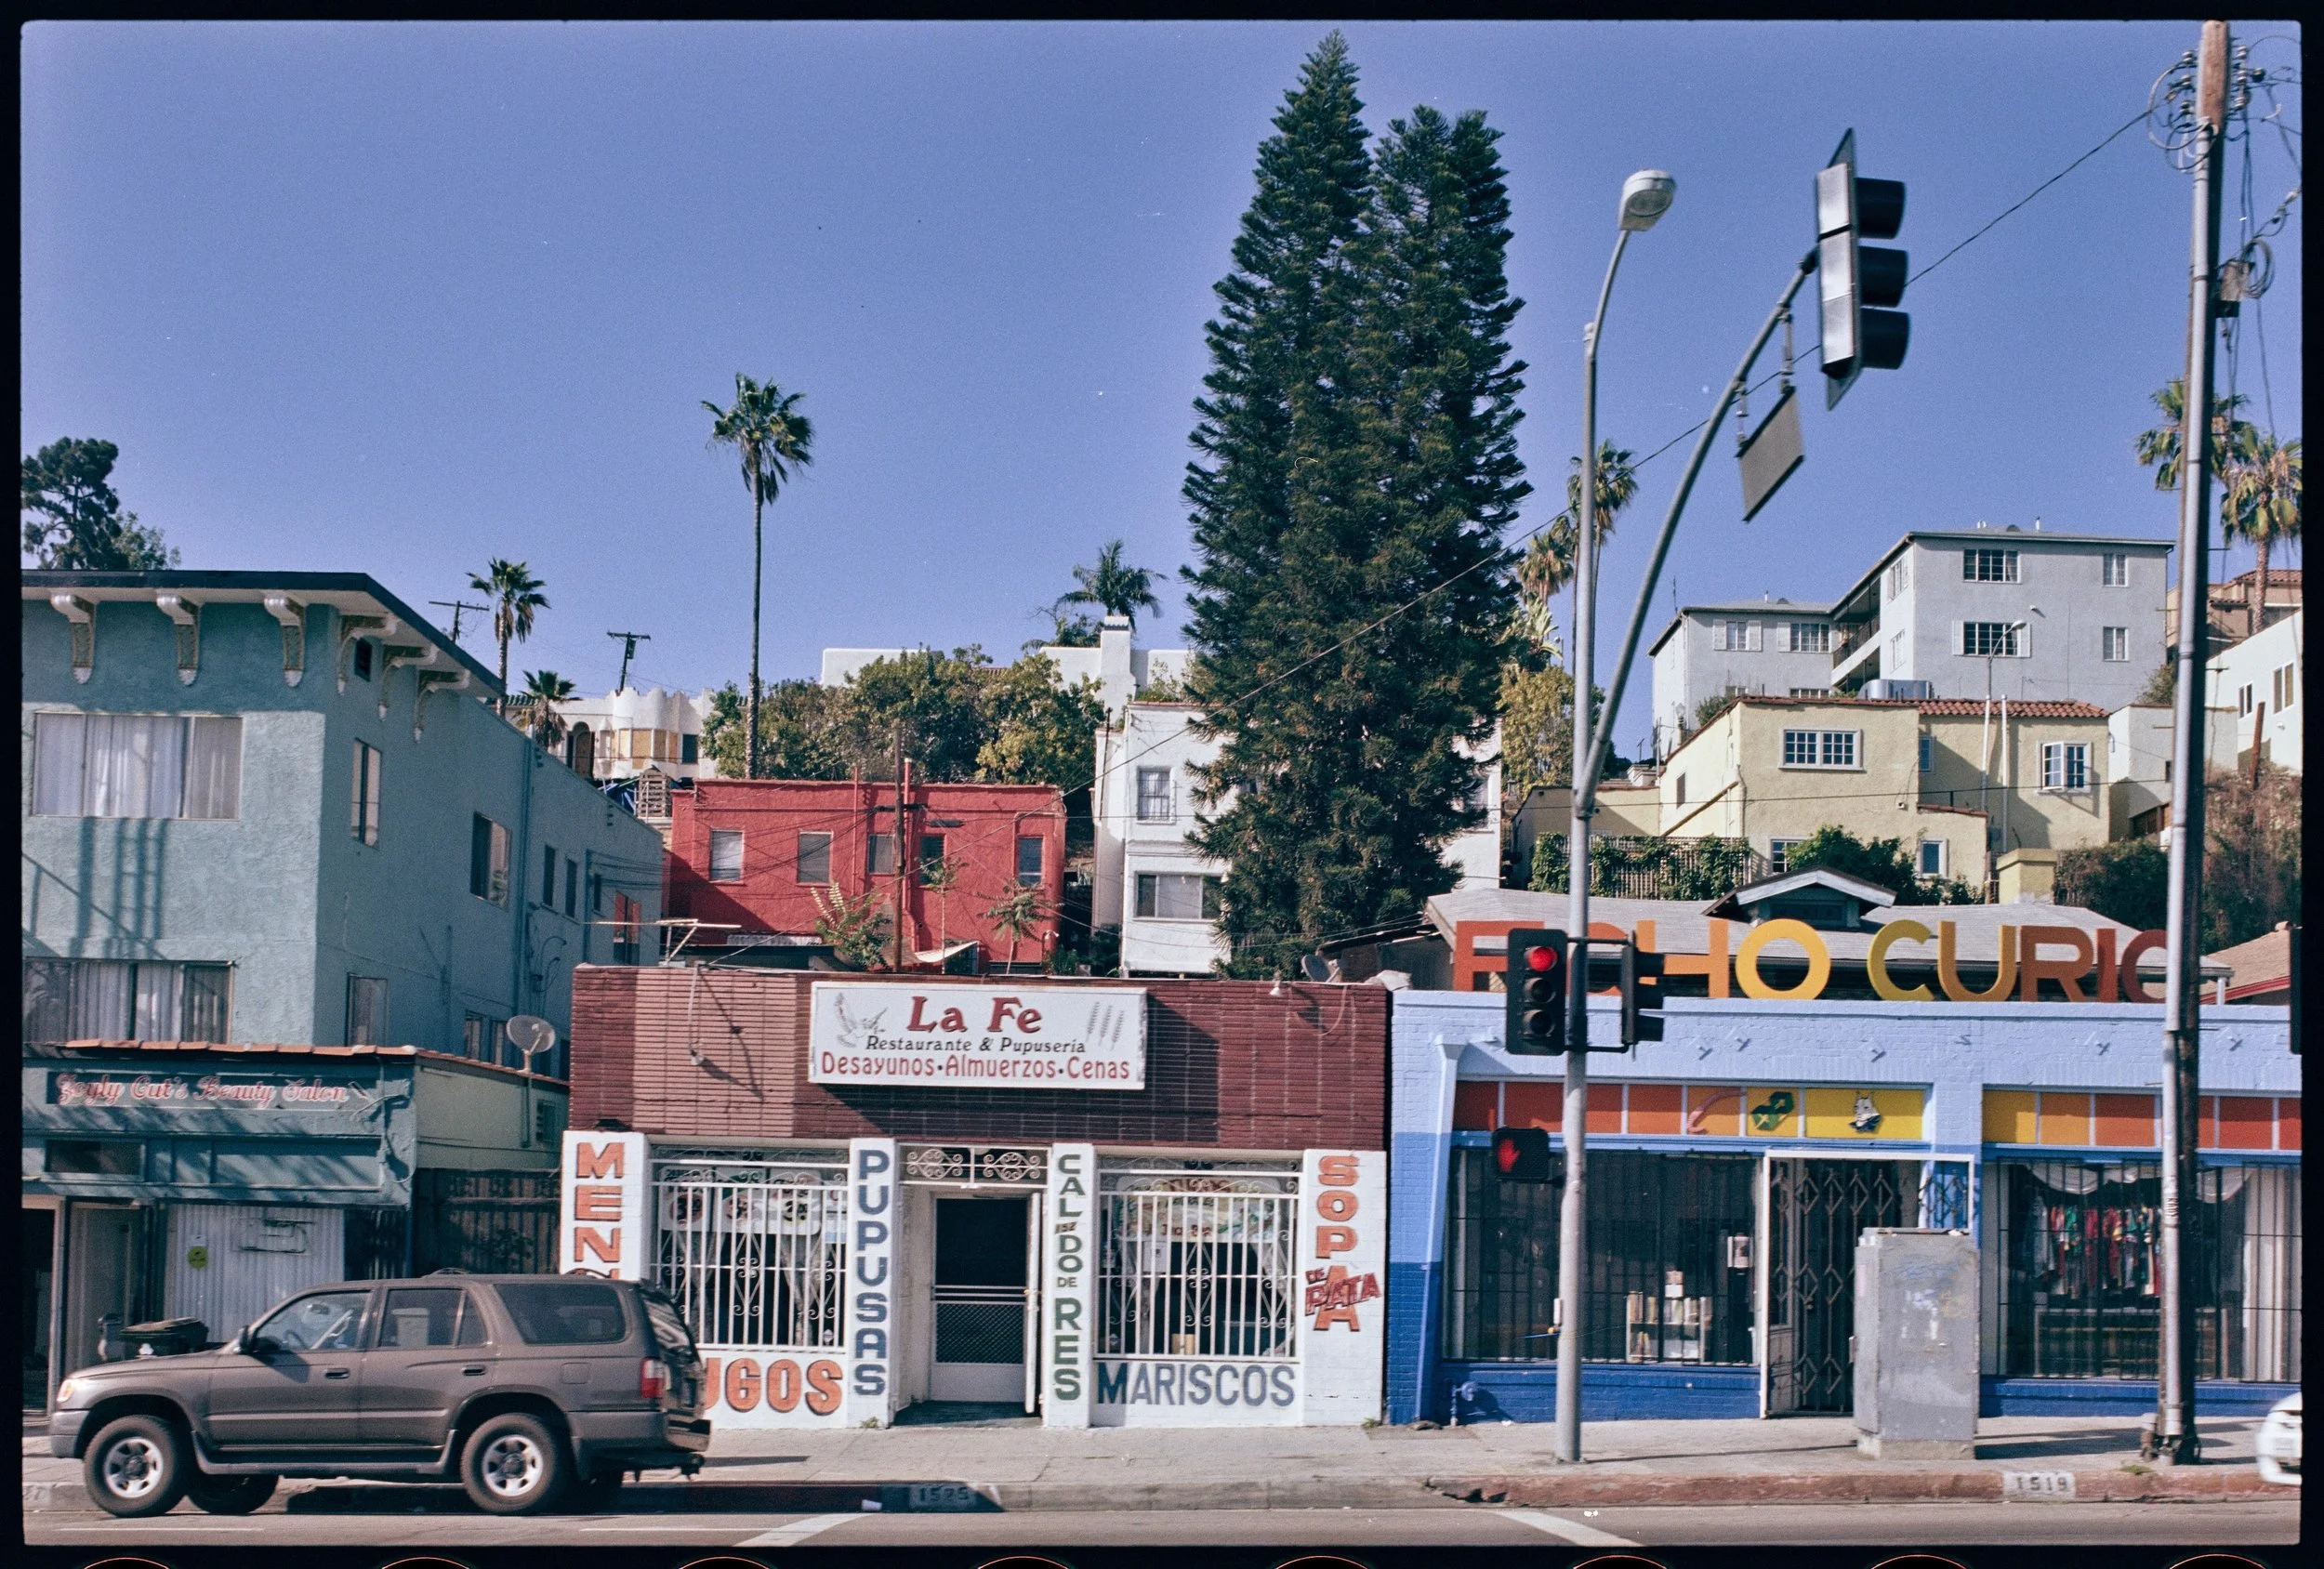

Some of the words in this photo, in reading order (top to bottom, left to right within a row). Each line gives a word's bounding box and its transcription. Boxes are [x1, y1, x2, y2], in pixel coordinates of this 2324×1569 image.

[906, 995, 968, 1033] La
[986, 996, 1042, 1034] Fe
[865, 1035, 972, 1051] Restaurante
[979, 1036, 992, 1051] &
[822, 1051, 934, 1076] Desayunos
[944, 1053, 1056, 1078] Almuerzos
[1067, 1056, 1129, 1079] Cenas
[192, 1075, 278, 1109] Beauty
[282, 1078, 350, 1101] Salon
[573, 1142, 626, 1279] MEN
[1057, 1154, 1086, 1273] CALDO
[853, 1149, 890, 1396] PUPUSAS
[1057, 1276, 1077, 1288] DE
[1305, 1268, 1327, 1285] DE
[1305, 1272, 1381, 1317] PATA
[1054, 1297, 1082, 1401] RES
[1097, 1361, 1296, 1407] MARISCOS
[2016, 1476, 2067, 1491] 1519
